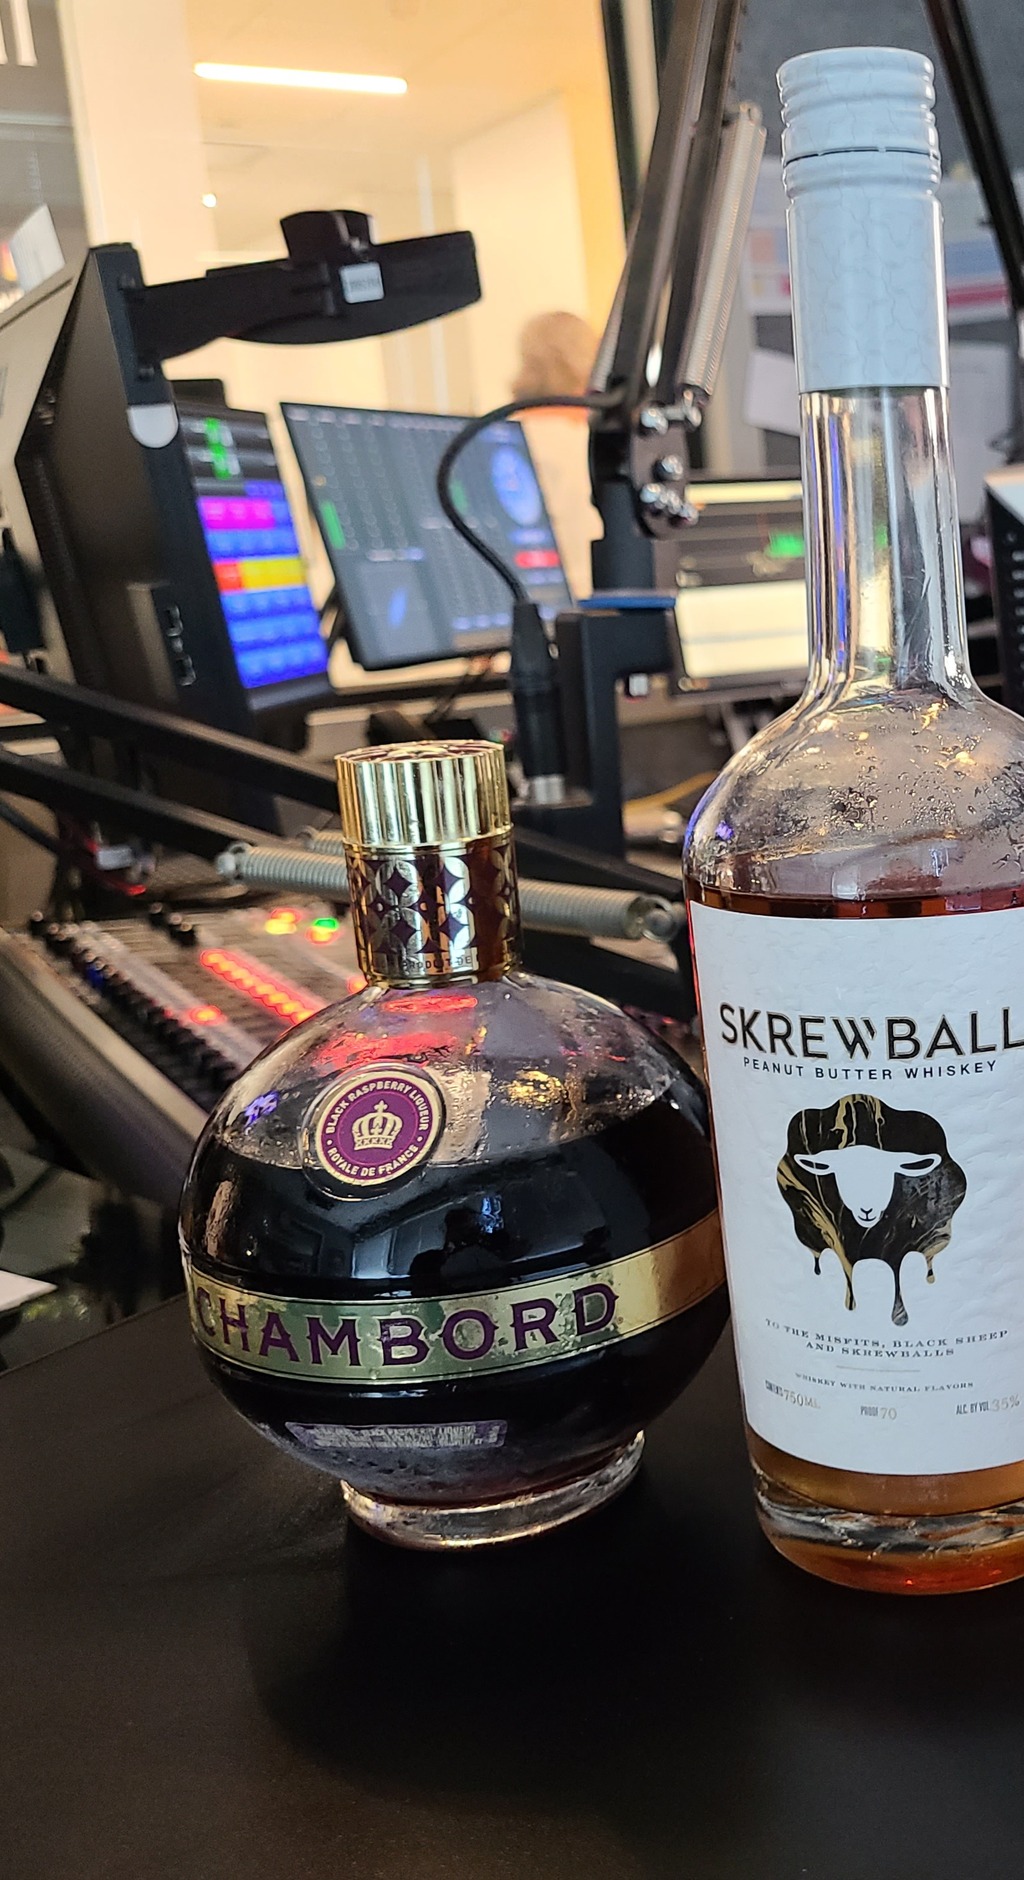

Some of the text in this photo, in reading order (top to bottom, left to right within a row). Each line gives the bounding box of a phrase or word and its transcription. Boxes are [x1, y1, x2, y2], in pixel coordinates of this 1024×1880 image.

[743, 1056, 998, 1081] PEANUT BUTTER WHISKEY
[325, 1081, 430, 1134] BLACK RASPBERRY LIQUEUR
[327, 1144, 419, 1177] ROYALE DE FRANCE
[195, 1283, 620, 1367] CHAMBORD
[765, 1318, 780, 1330] TO
[785, 1325, 809, 1338] THE
[893, 1338, 948, 1348] BLACK
[955, 1330, 1009, 1345] SHEEP
[806, 1341, 955, 1358] AND SKREWBALLS
[795, 1372, 974, 1393] WHISKEY WITH NATURAL FLAVORS
[860, 1405, 898, 1421] PROOF 70
[970, 1403, 978, 1414] BY
[991, 1394, 1021, 1413] 35%
